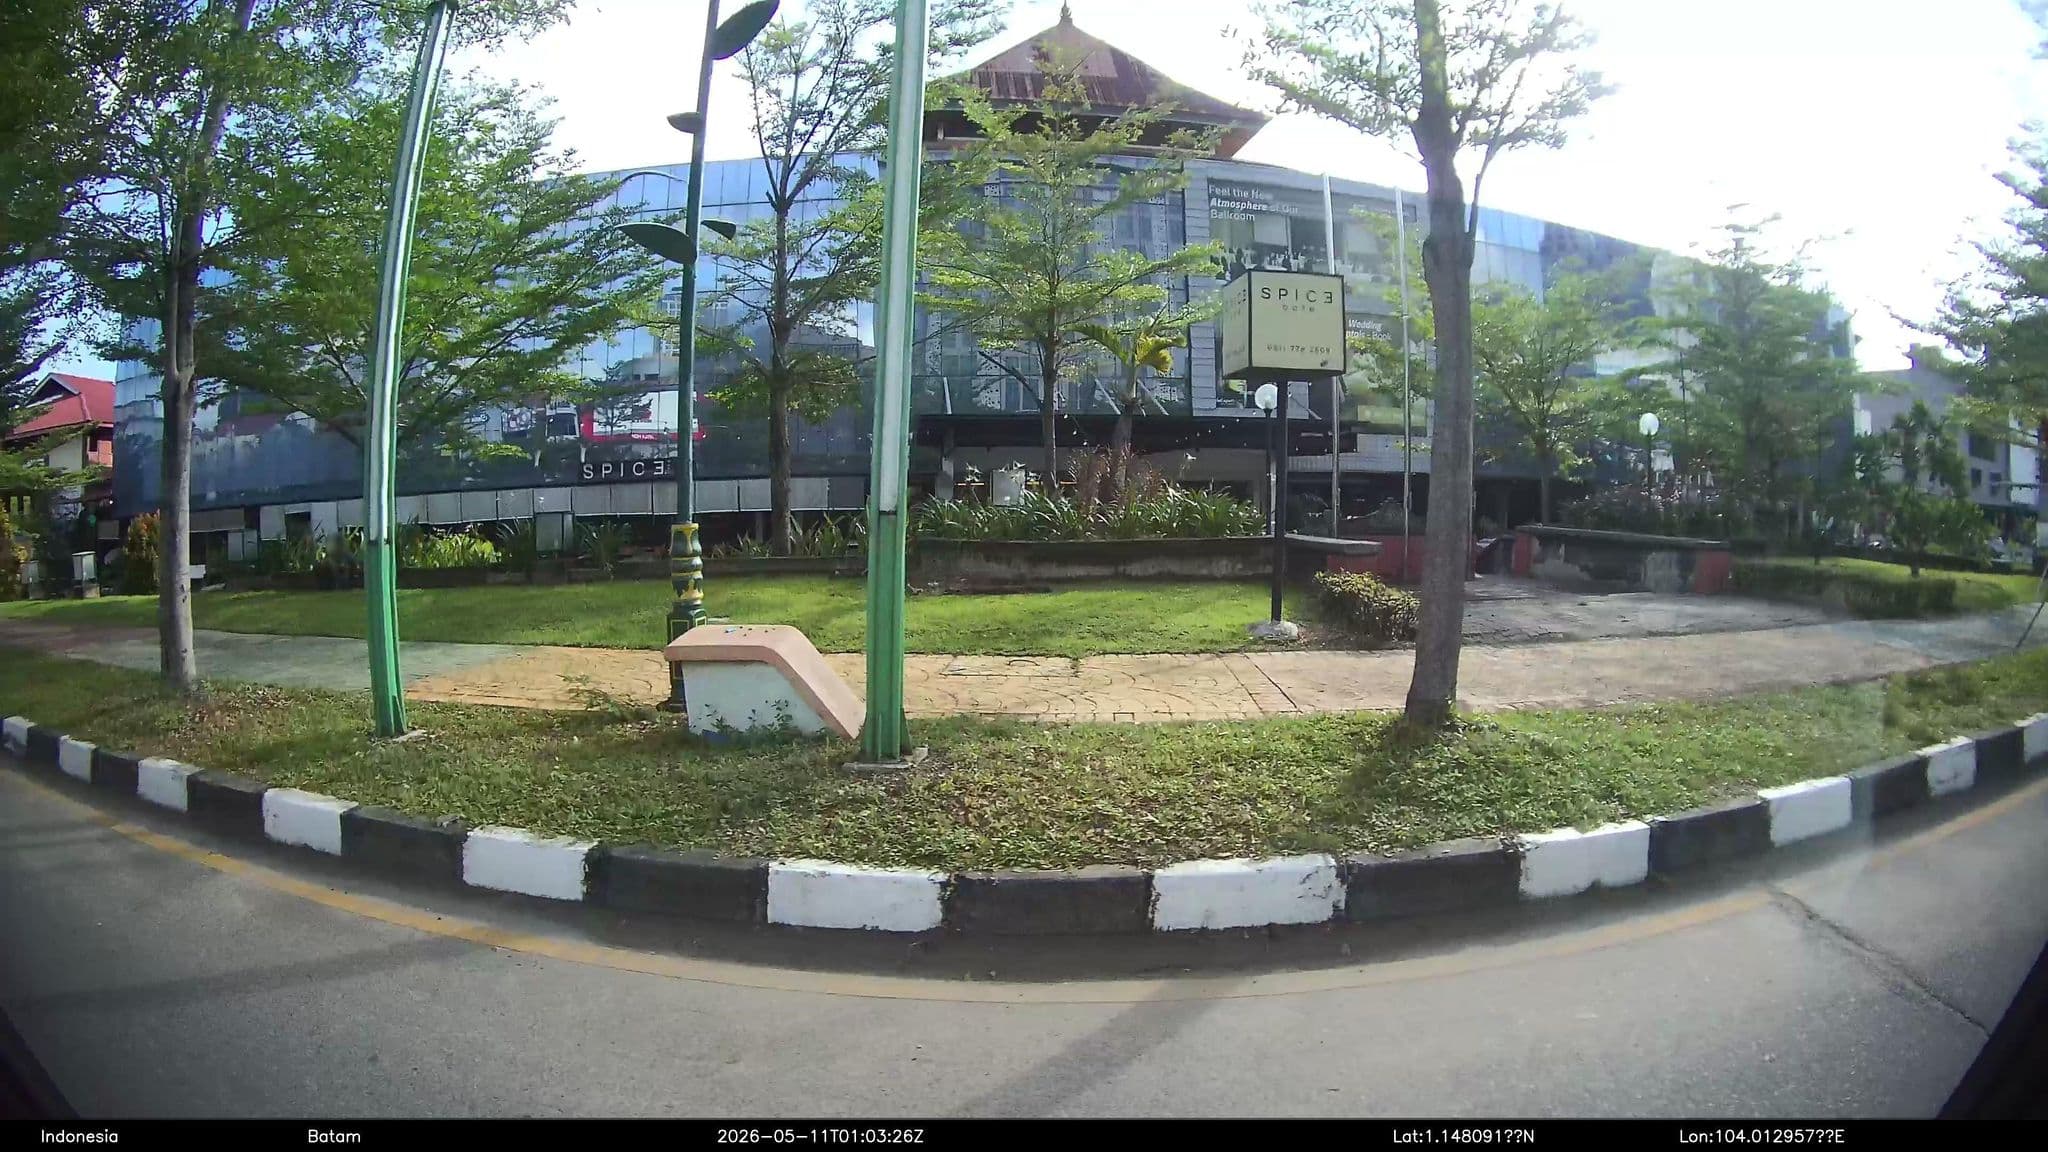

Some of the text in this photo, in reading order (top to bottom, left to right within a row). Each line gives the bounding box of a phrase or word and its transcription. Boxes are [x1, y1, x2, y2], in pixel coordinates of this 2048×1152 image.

[1208, 184, 1231, 197] Feel
[1232, 188, 1249, 198] the
[1210, 197, 1269, 211] Atmosphere
[1210, 208, 1256, 221] Ballroom
[1348, 318, 1383, 332] Wedding
